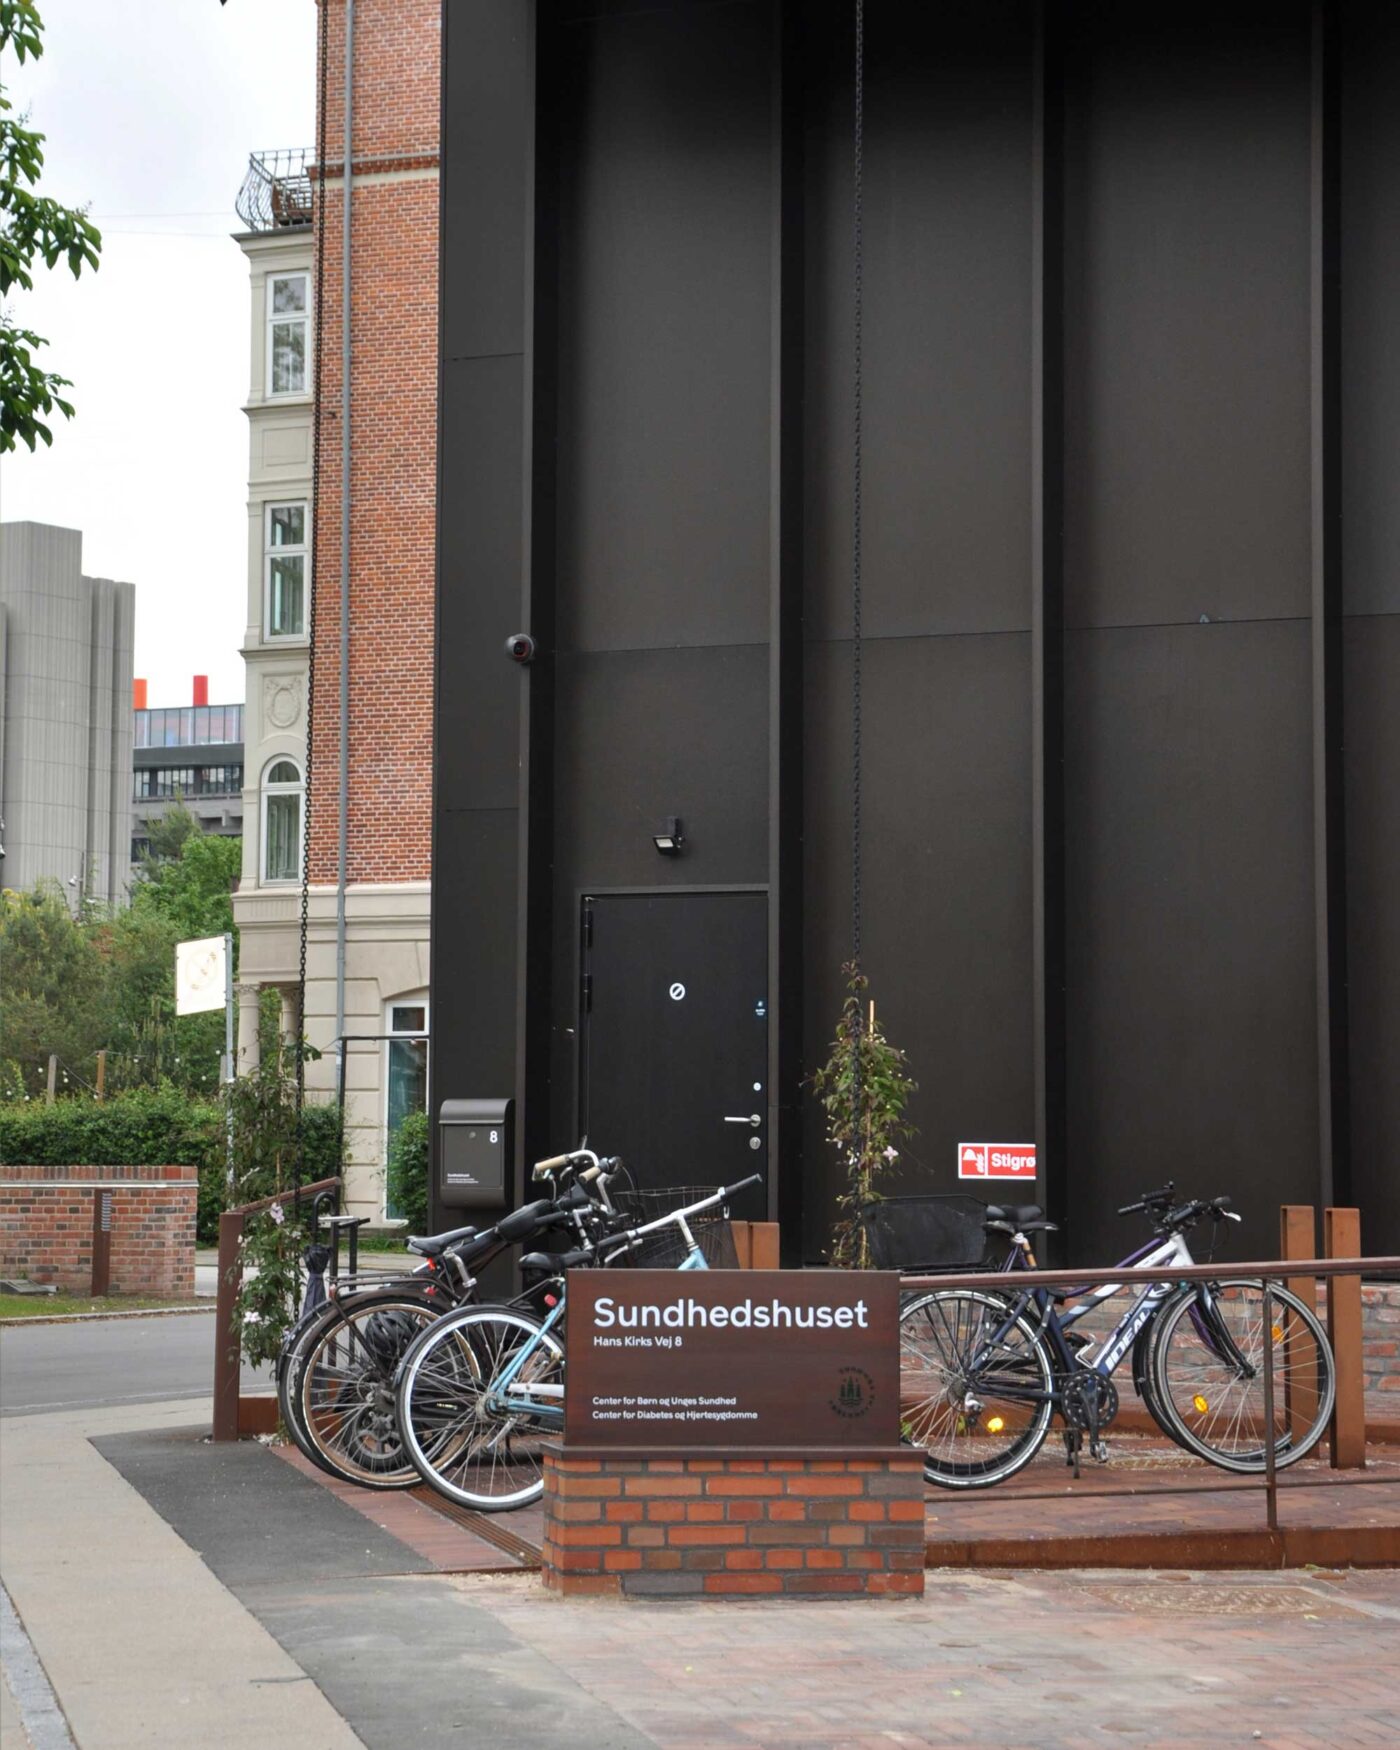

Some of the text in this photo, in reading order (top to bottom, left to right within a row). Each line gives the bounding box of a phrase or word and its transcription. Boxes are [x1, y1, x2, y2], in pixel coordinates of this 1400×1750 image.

[489, 1130, 498, 1144] 8
[594, 1297, 869, 1328] Sundhedshuset
[593, 1336, 683, 1349] Hans Kirks Vej 8
[1104, 1308, 1151, 1371] IDEAL
[592, 1396, 737, 1407] Center for Børn og Unges Sundhed
[592, 1410, 758, 1421] Center for Diabetes og Hjertesygdomme
